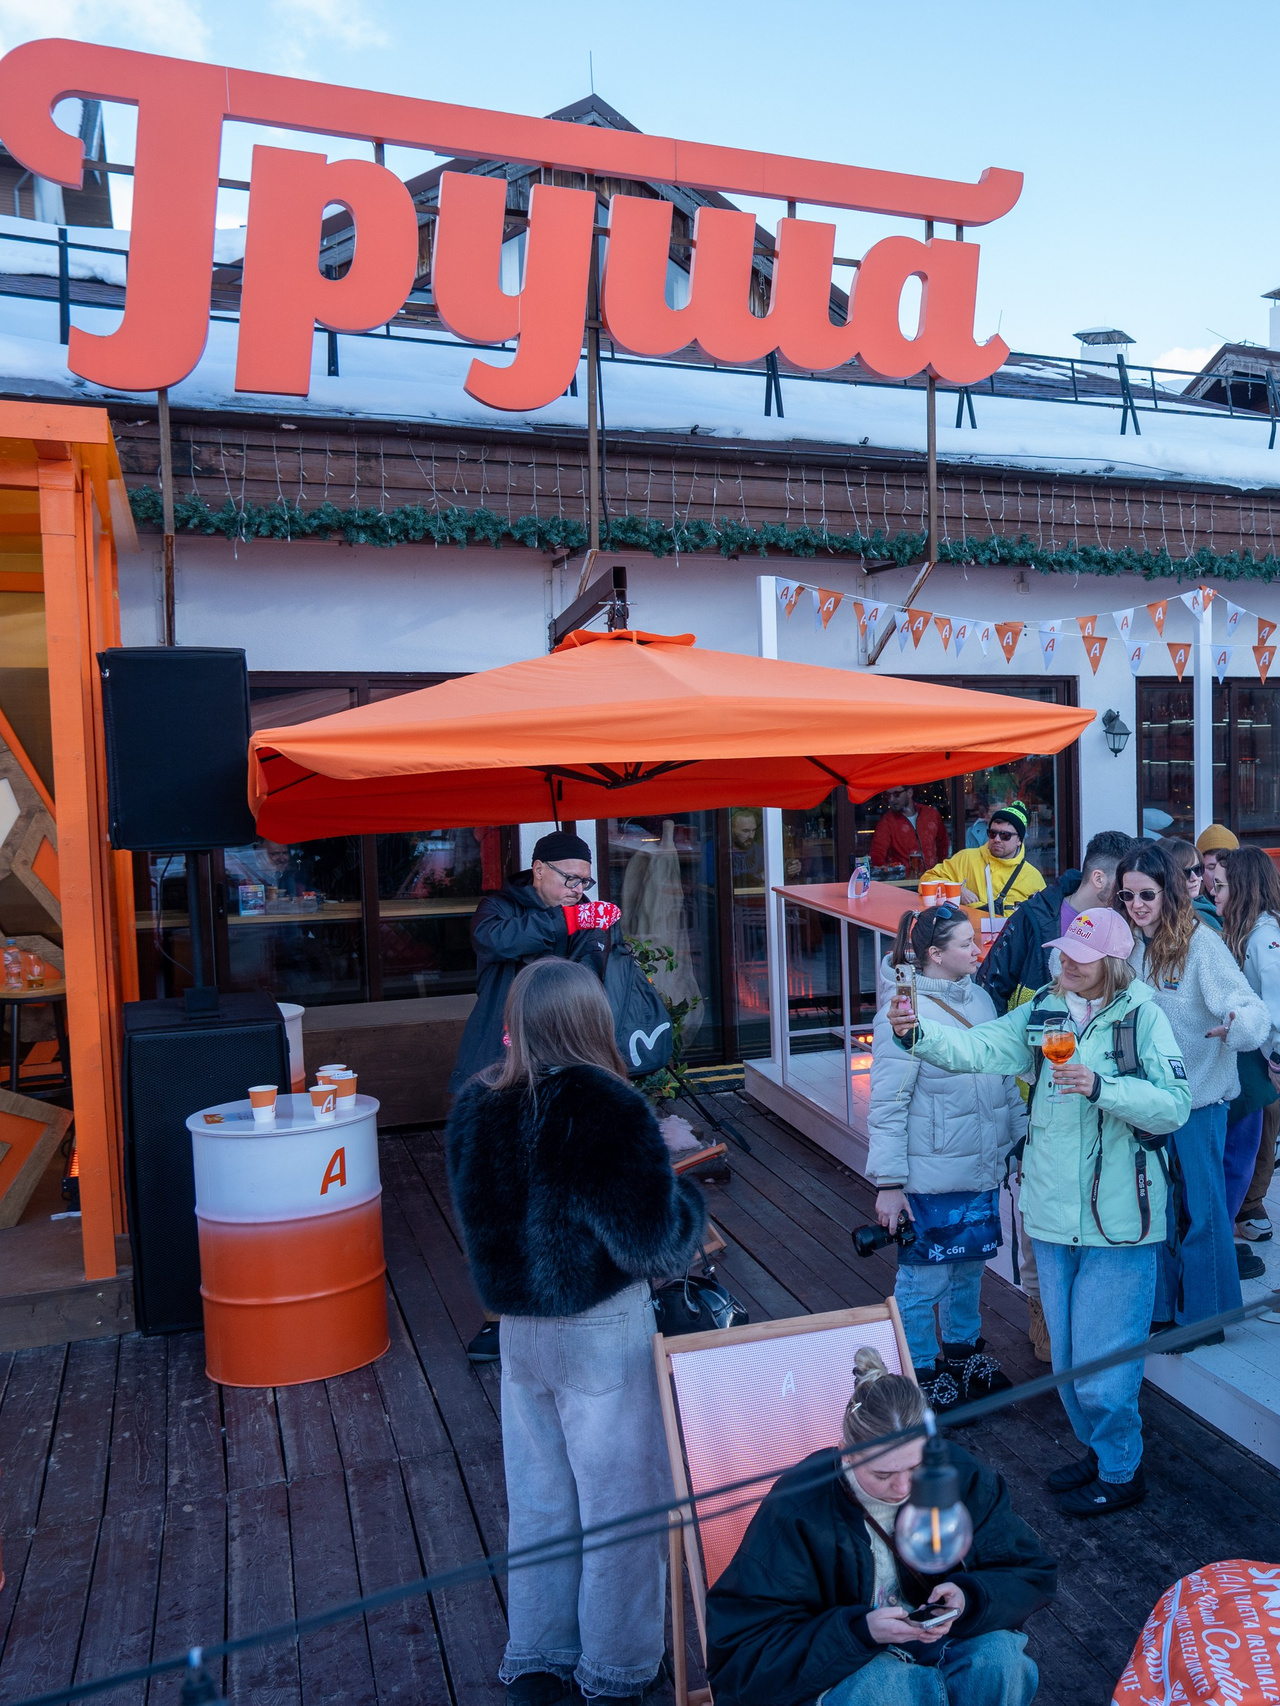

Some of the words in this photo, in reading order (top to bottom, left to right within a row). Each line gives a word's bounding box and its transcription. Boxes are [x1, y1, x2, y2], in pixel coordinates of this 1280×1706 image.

[0, 38, 1024, 411] Груша
[1076, 928, 1092, 941] Bull
[1178, 1631, 1211, 1697] SELEZIONATE
[1245, 1633, 1280, 1702] ORIGINALE
